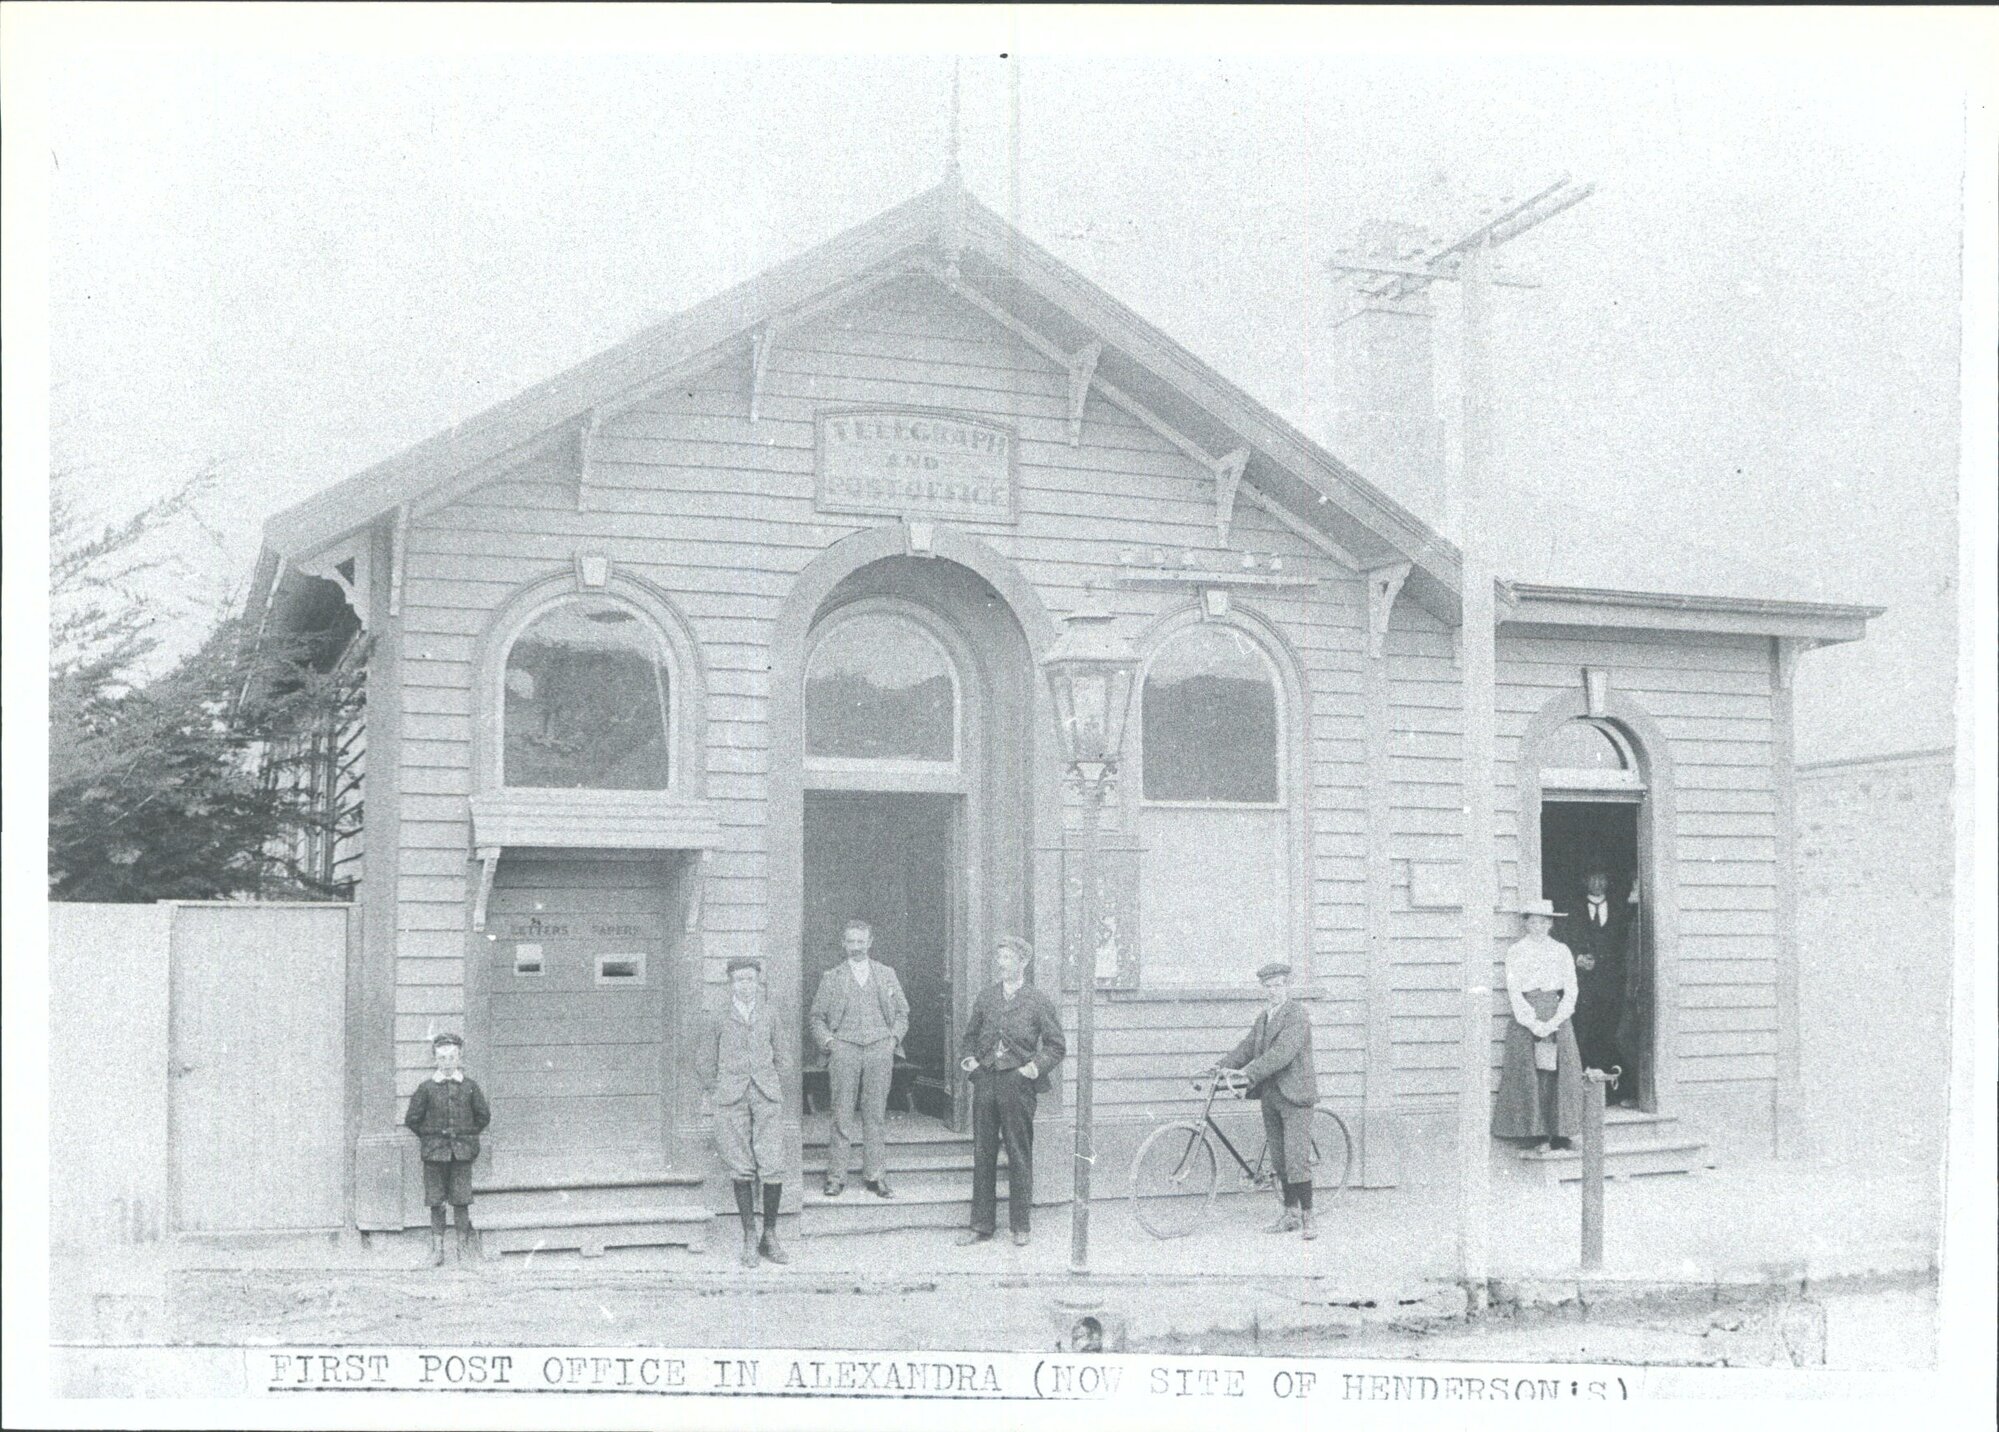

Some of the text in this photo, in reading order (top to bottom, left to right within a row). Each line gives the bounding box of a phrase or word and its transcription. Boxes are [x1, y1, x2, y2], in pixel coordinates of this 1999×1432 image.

[832, 421, 1006, 455] TELEGRAPH
[885, 453, 940, 469] AND
[510, 925, 569, 935] LETTERS
